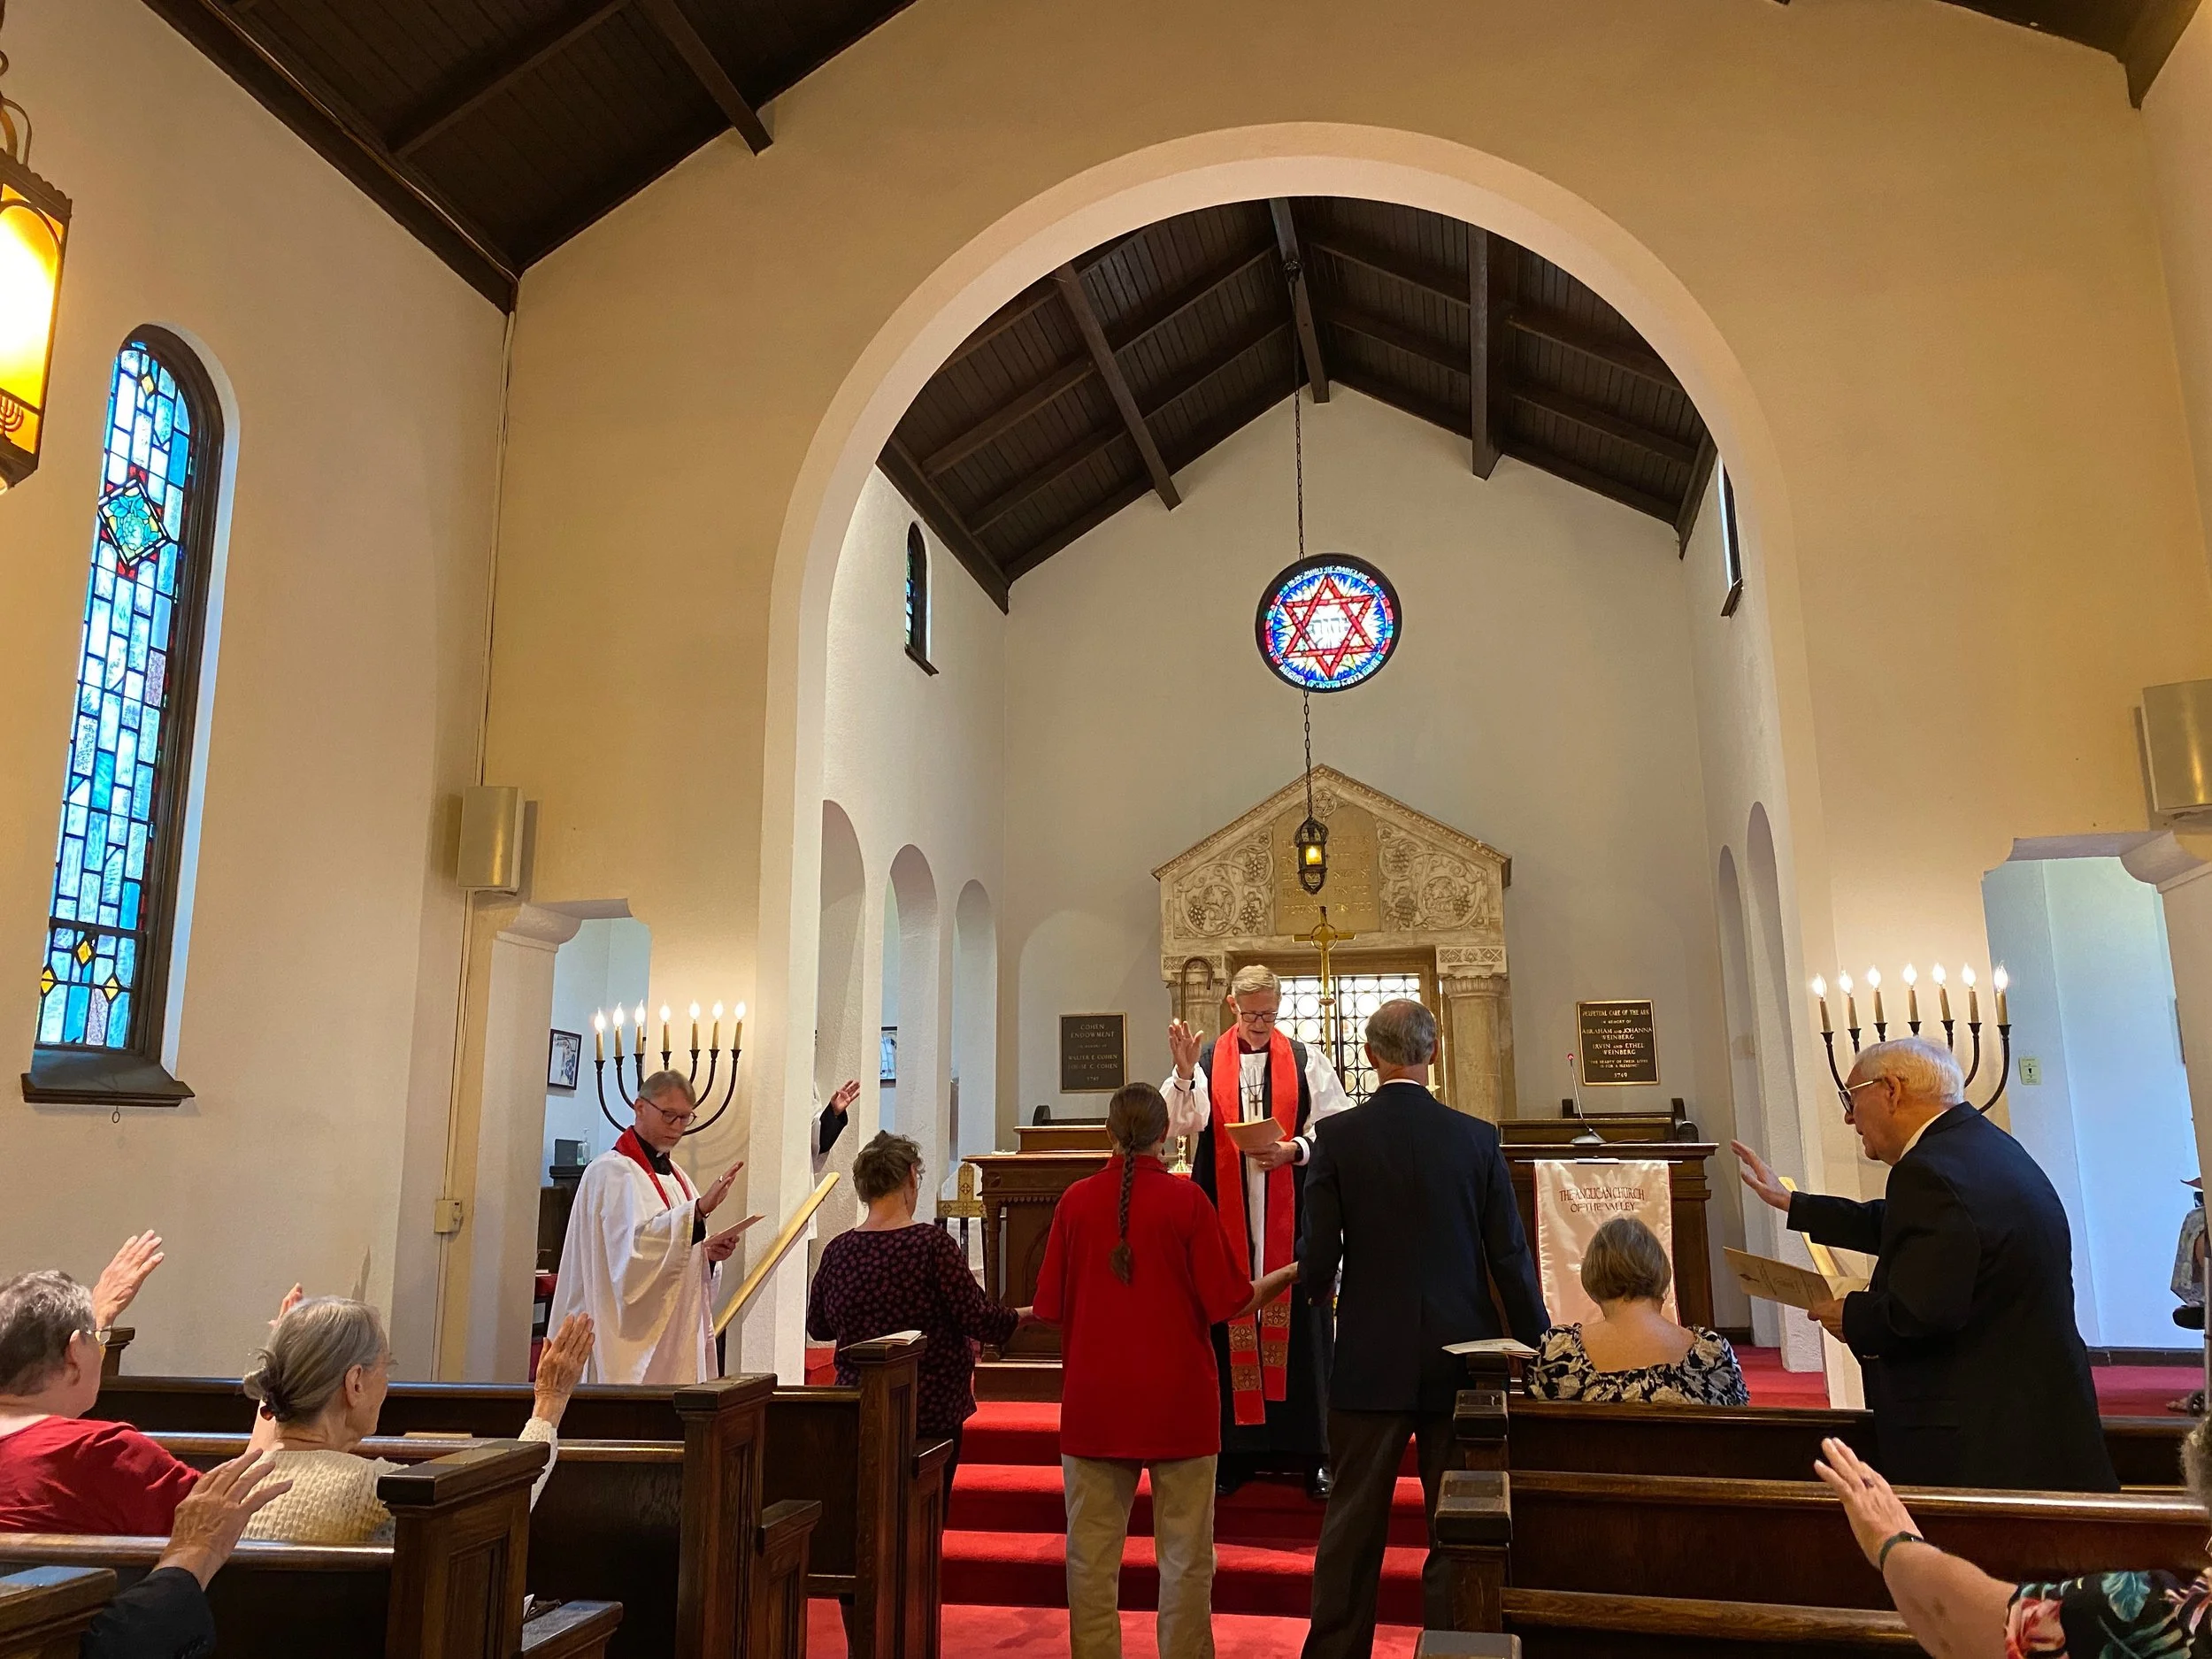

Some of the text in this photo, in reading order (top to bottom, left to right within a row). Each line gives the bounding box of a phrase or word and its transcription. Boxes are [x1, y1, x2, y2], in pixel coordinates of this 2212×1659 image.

[1559, 1187, 1645, 1202] THE ANGLICAN CHURCH
[1570, 1202, 1635, 1212] OF THE VALLEY
